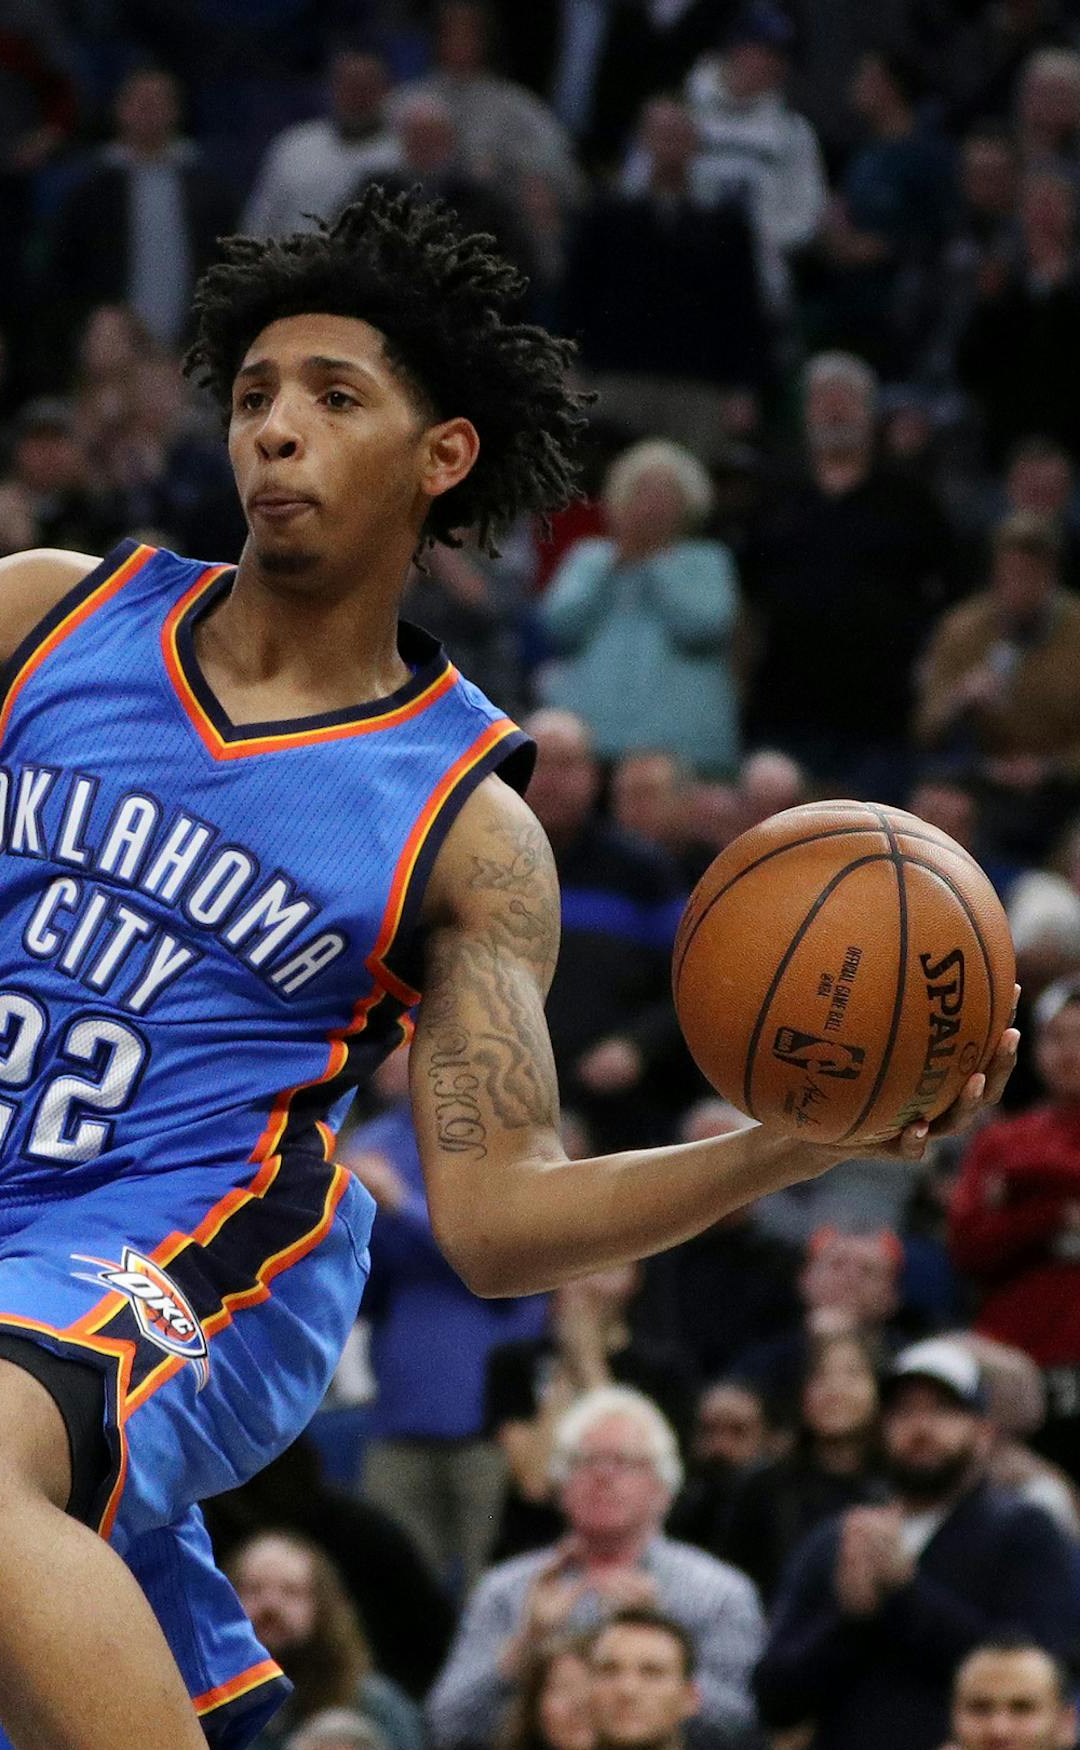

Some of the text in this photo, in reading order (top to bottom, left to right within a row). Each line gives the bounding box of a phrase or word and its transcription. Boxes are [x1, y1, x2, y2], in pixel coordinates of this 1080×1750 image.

[24, 876, 203, 1014] CITY
[824, 946, 862, 1032] OFFICIAL GAME BALL
[102, 1272, 195, 1335] OKC
